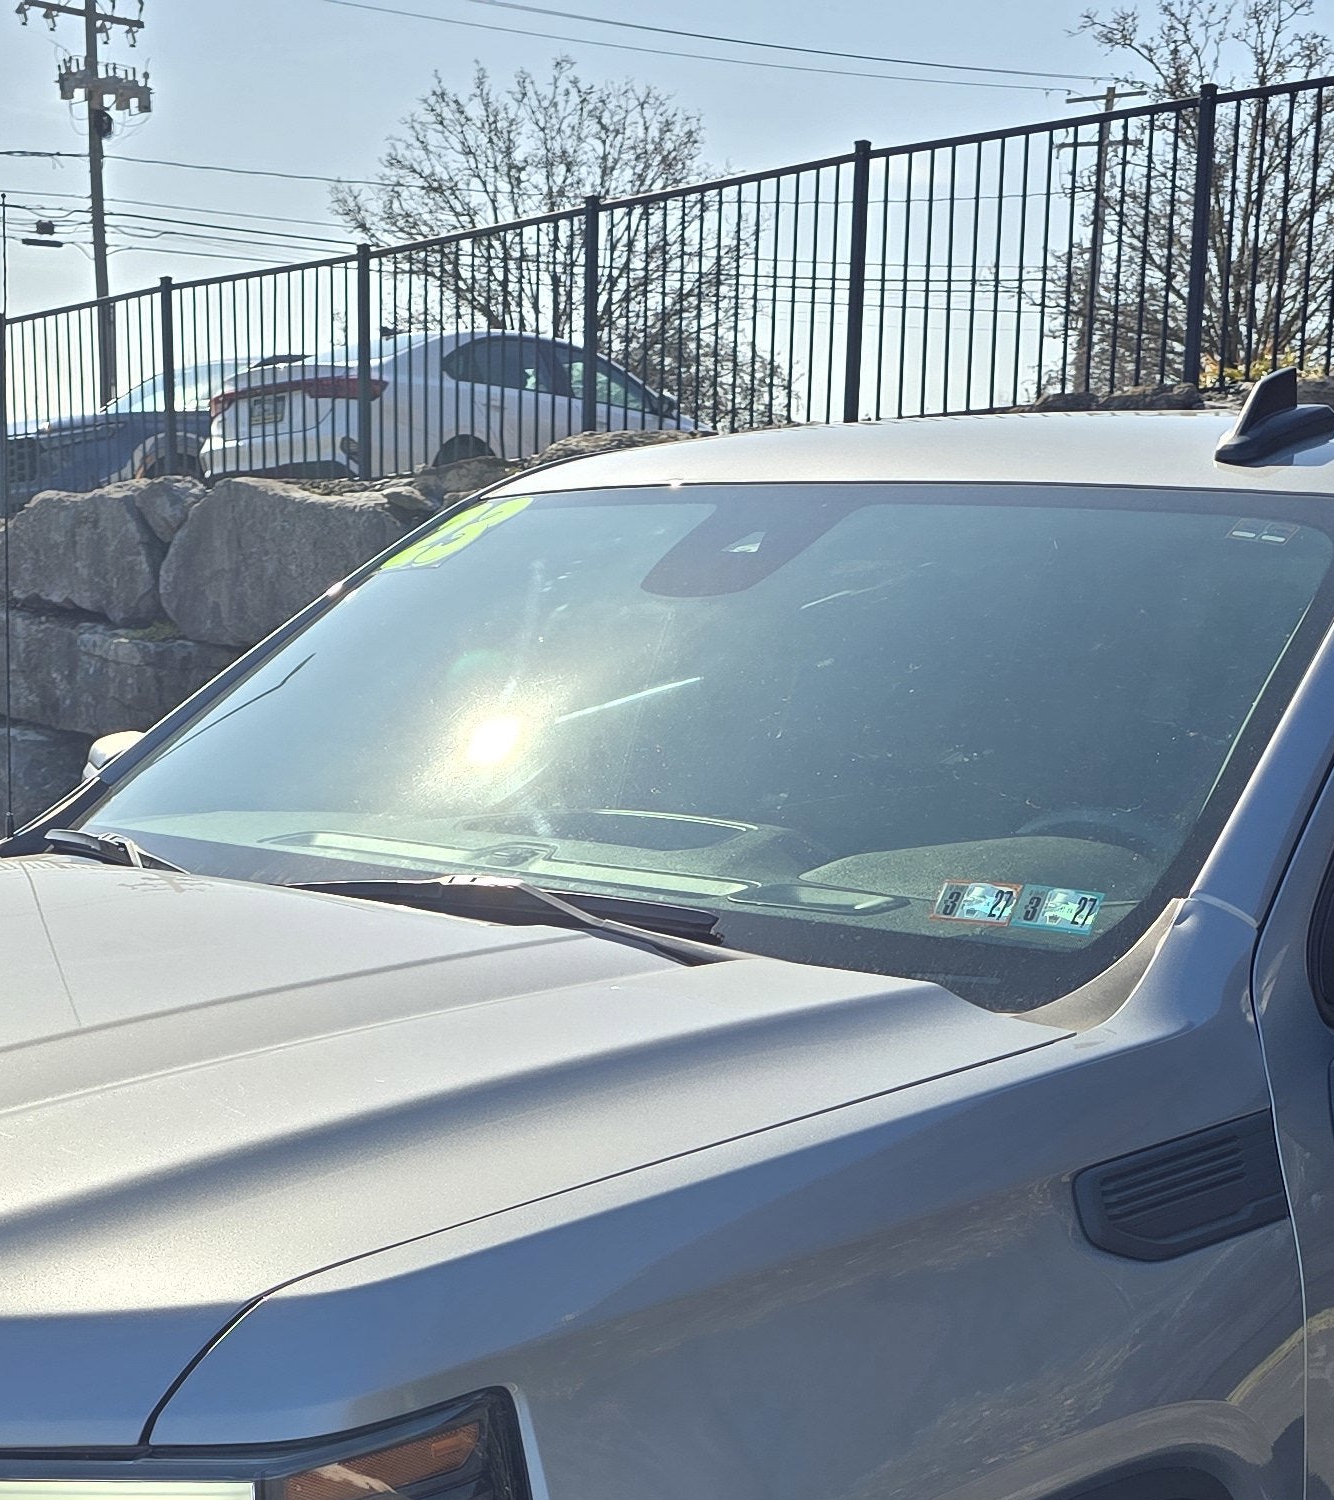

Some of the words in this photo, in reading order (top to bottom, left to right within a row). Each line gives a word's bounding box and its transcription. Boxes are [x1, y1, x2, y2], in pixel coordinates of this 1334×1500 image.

[942, 891, 962, 916] 3
[987, 889, 1014, 921] 27
[1023, 896, 1042, 922] 3
[1070, 896, 1098, 928] 27
